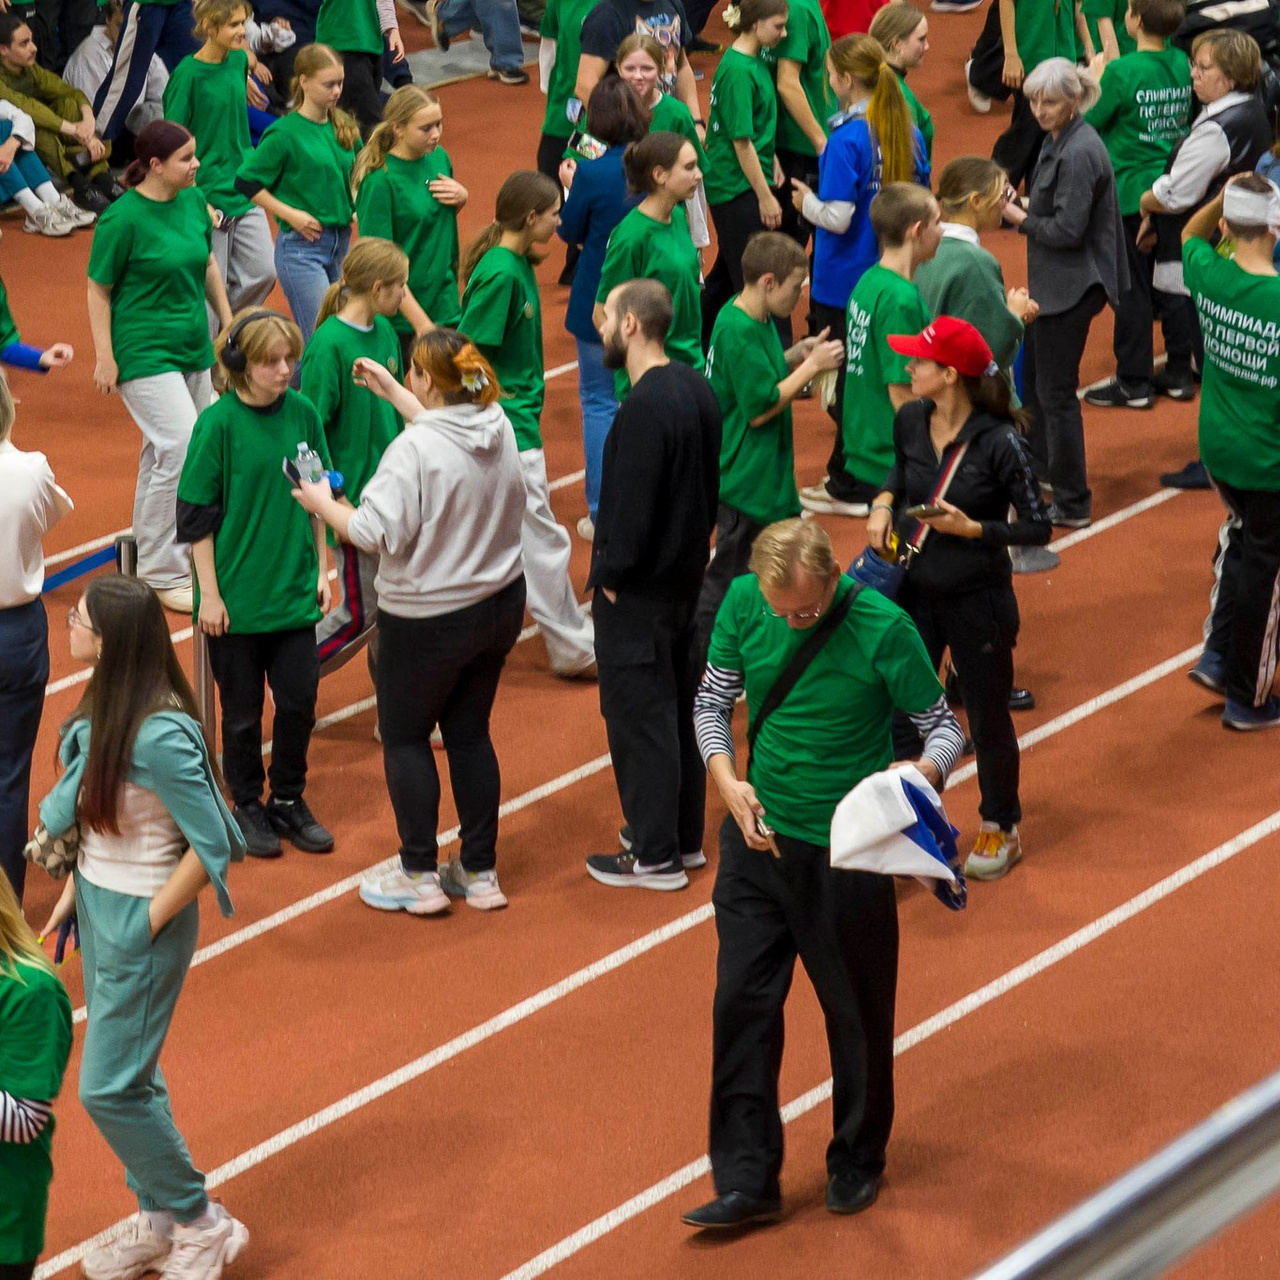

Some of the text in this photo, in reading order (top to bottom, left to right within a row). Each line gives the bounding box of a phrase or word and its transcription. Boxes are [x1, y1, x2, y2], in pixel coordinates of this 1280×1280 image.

[1139, 105, 1156, 118] ПО
[1204, 332, 1267, 371] ПОМОЩИ
[1215, 324, 1279, 357] ПЕРВОЙ
